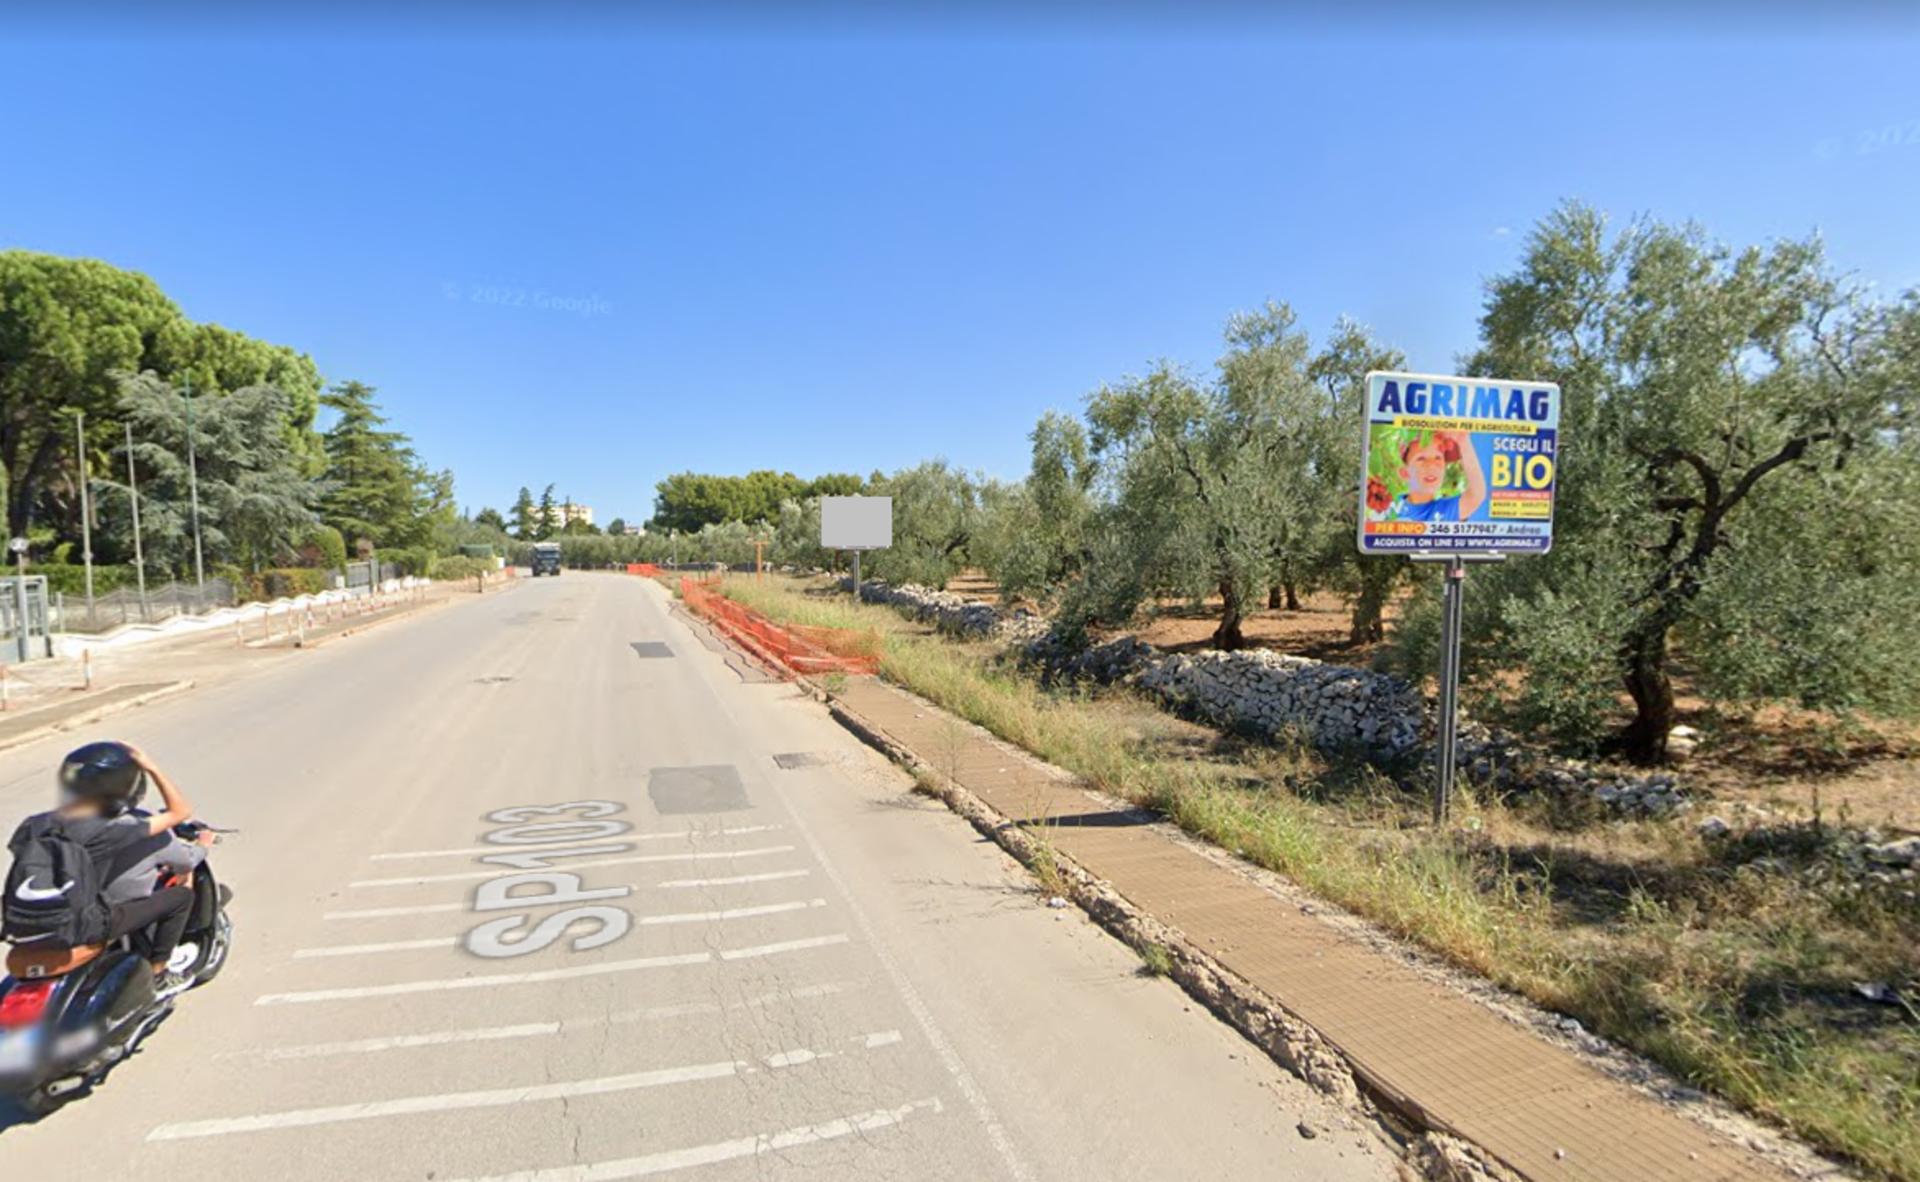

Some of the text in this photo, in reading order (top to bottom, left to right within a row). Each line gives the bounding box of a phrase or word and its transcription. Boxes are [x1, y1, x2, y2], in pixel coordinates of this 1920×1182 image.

[1377, 380, 1550, 422] AGRIMAG
[1401, 418, 1458, 430] BIOSOLUZIONI
[1459, 421, 1474, 431] PER
[1492, 437, 1553, 453] SCEGLI IL
[1491, 453, 1554, 489] BIO
[1430, 523, 1450, 534] 346
[1373, 538, 1416, 547] ACQUISTA
[1418, 538, 1432, 547] ON
[1434, 539, 1453, 547] LINE
[1454, 539, 1466, 548] SU
